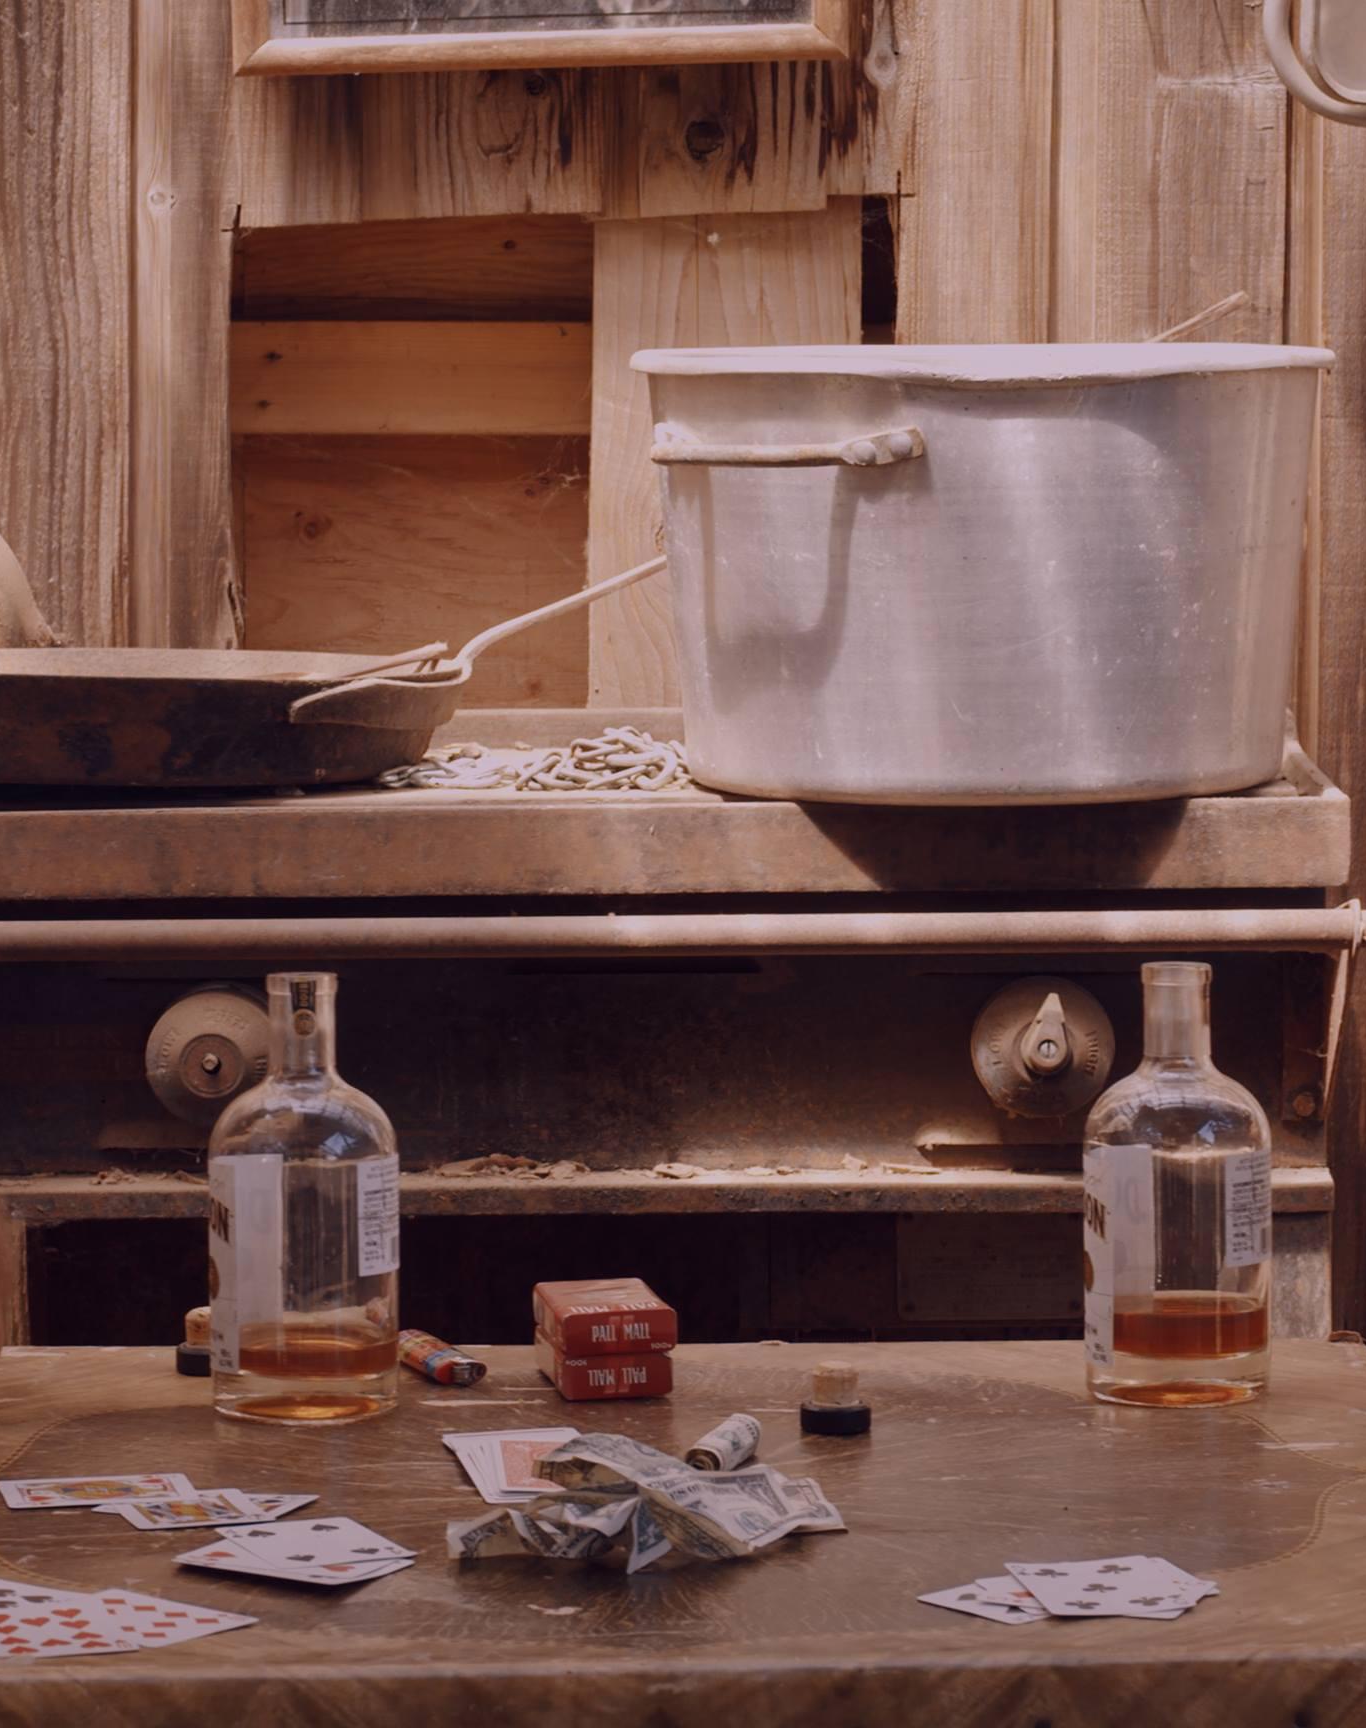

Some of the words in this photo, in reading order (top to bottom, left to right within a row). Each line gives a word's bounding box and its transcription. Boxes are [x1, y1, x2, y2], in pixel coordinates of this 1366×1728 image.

[591, 1325, 617, 1343] PALL
[623, 1322, 651, 1340] MALL
[587, 1369, 615, 1387] MALL
[621, 1366, 647, 1384] PALL
